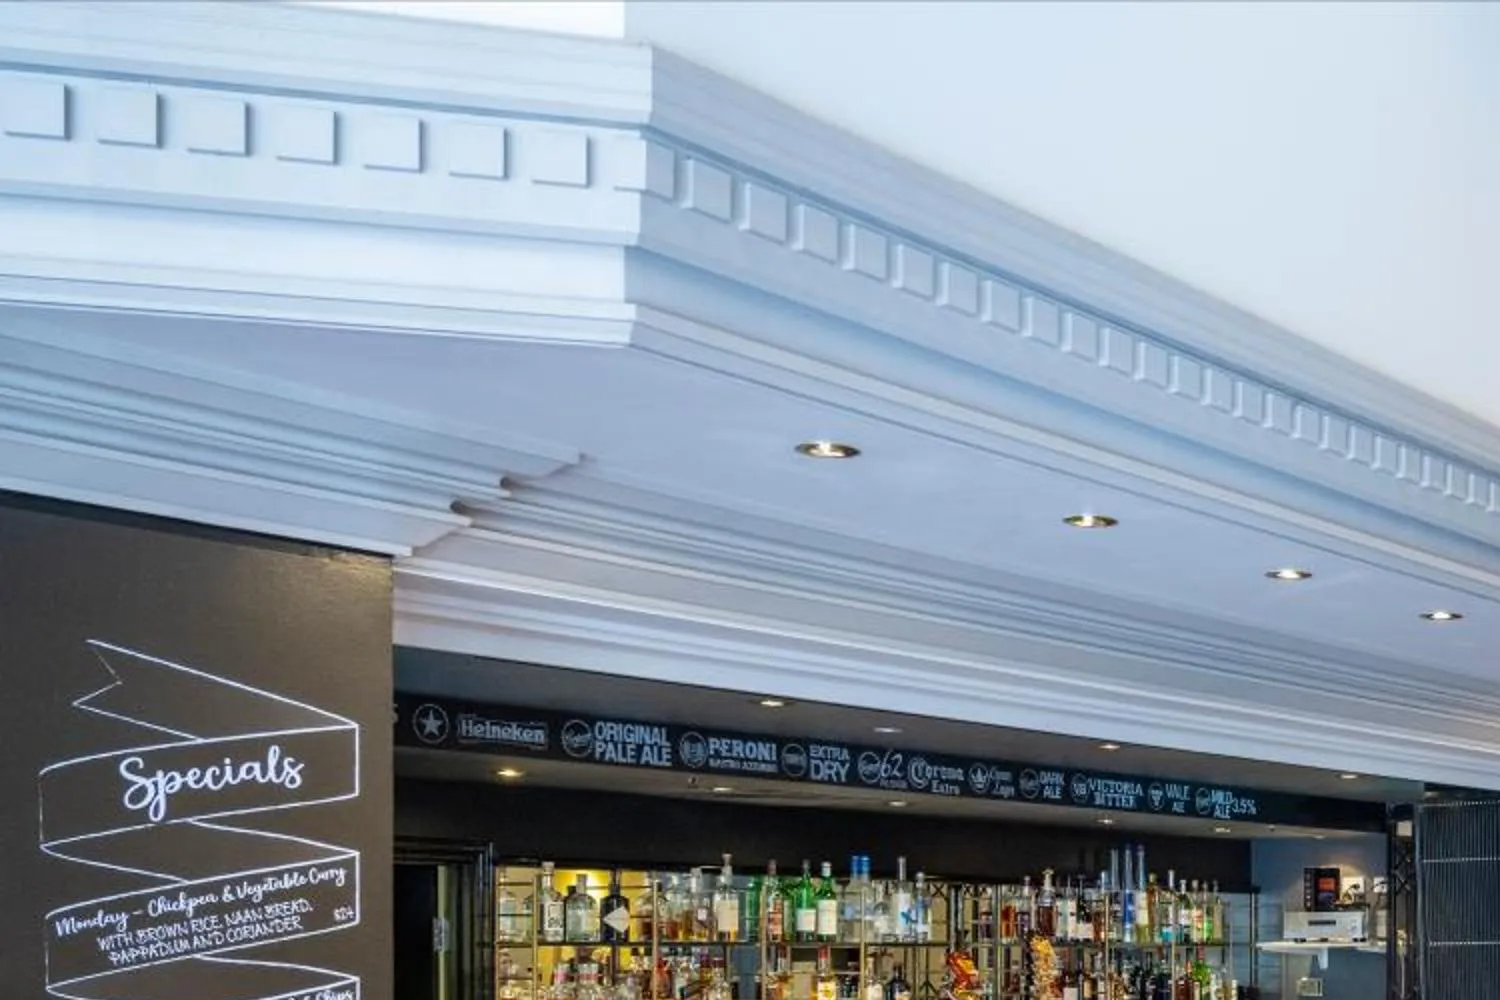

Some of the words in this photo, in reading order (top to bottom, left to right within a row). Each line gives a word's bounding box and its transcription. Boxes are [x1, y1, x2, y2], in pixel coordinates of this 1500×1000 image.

[461, 718, 545, 744] Heineken
[595, 721, 671, 746] ORIGINAL
[595, 741, 637, 763] PALE
[640, 745, 672, 766] ALE
[708, 737, 777, 761] PERONI
[809, 745, 850, 760] EXTRA
[119, 745, 304, 822] Specials
[809, 760, 850, 782] DRY
[908, 757, 964, 789] Corona
[1043, 786, 1061, 799] ALE
[1087, 777, 1143, 797] VICTORIA
[1094, 791, 1137, 808] BITTER
[55, 909, 129, 936] Monday
[148, 892, 219, 917] Chickpea
[222, 885, 235, 902] &
[236, 872, 308, 903] Vegetable
[308, 867, 347, 887] Curry
[97, 931, 133, 951] WITH
[136, 922, 189, 944] BROWN
[224, 909, 263, 926] NAAN
[193, 931, 225, 949] AND
[226, 916, 304, 942] CORIANDER
